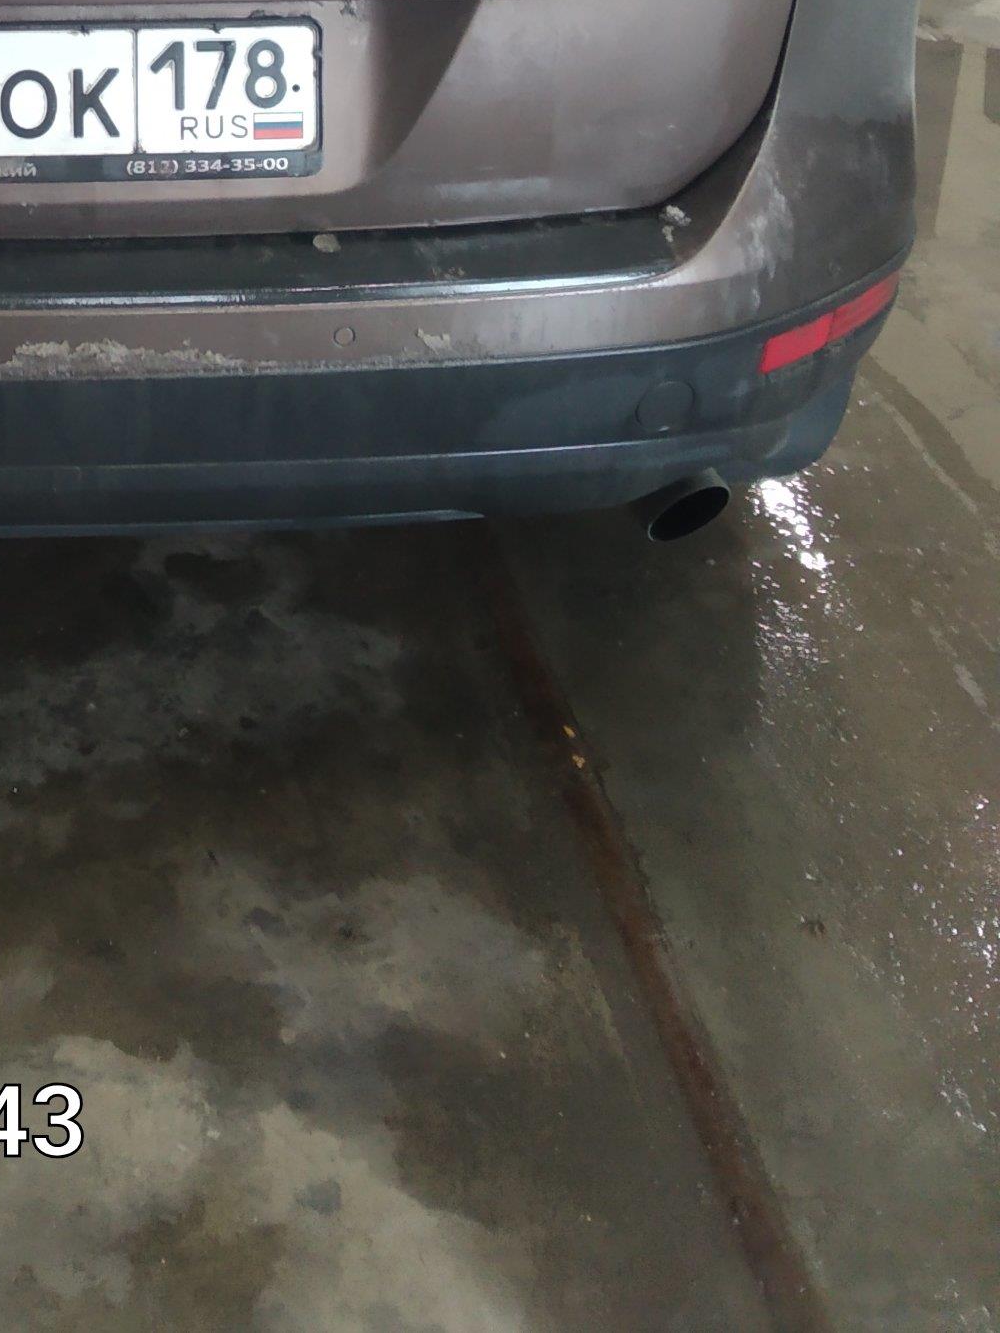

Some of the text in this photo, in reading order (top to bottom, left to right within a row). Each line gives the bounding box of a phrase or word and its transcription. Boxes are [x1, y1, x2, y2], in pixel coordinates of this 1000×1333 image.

[150, 40, 285, 110] 178
[180, 115, 249, 140] RUS
[185, 157, 289, 174] 334-35-00
